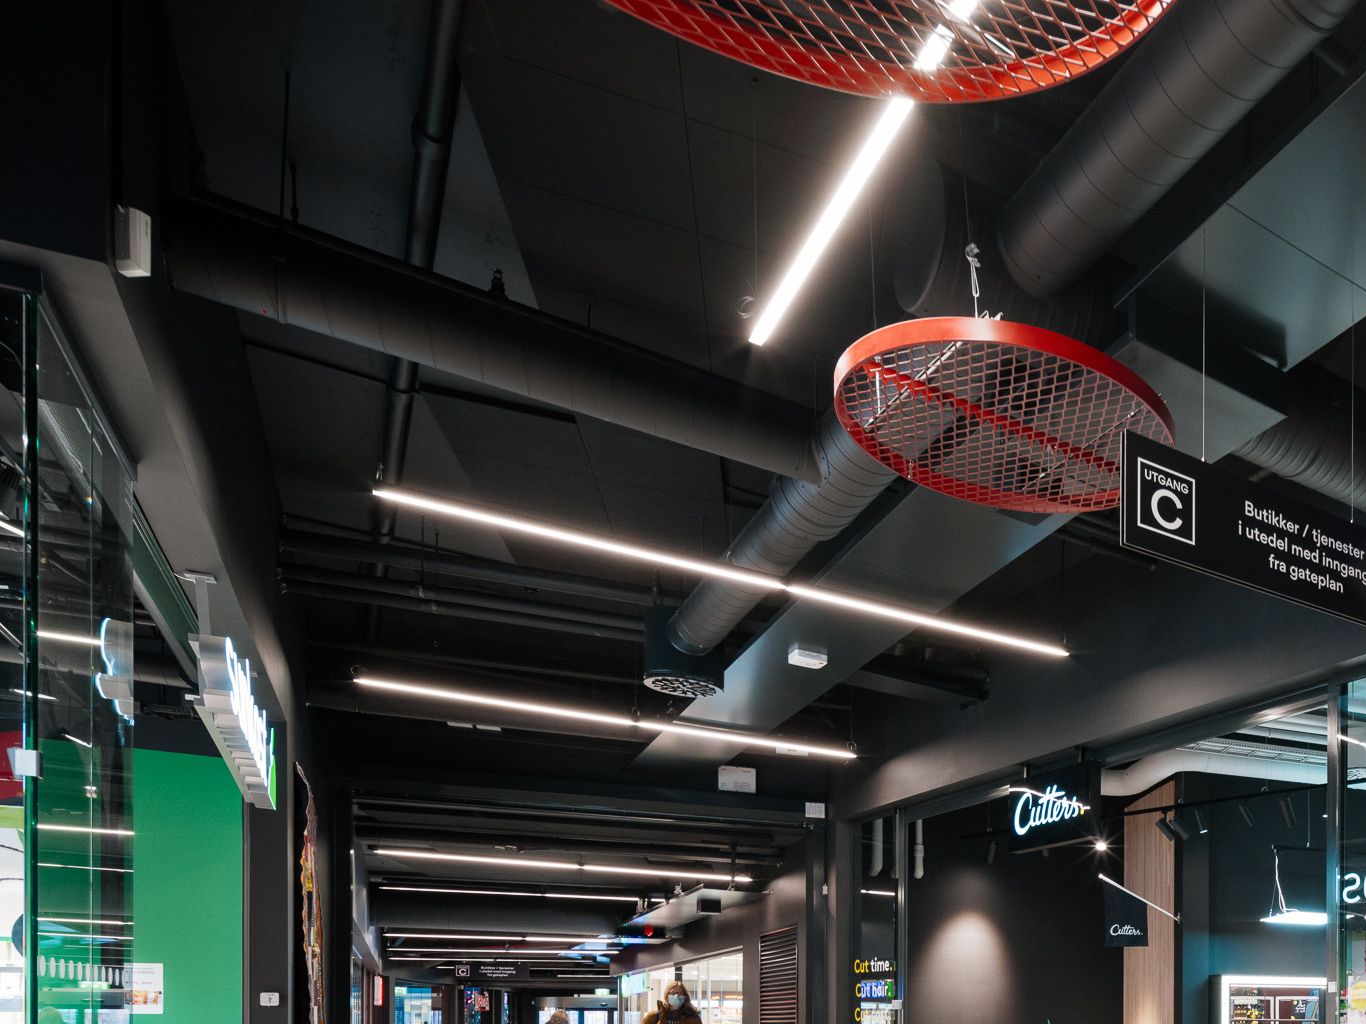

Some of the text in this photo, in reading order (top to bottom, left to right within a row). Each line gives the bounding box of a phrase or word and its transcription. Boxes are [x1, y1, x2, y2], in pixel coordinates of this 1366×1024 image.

[1144, 468, 1189, 495] UTGANG
[1151, 488, 1183, 530] C
[1238, 520, 1243, 536] i
[1246, 525, 1288, 552] utedel
[1291, 541, 1319, 564] med
[1244, 500, 1366, 560] Butikker / tjenester
[1269, 554, 1344, 593] fra gateplan
[854, 957, 893, 974] Cut time.
[855, 983, 871, 998] Cut
